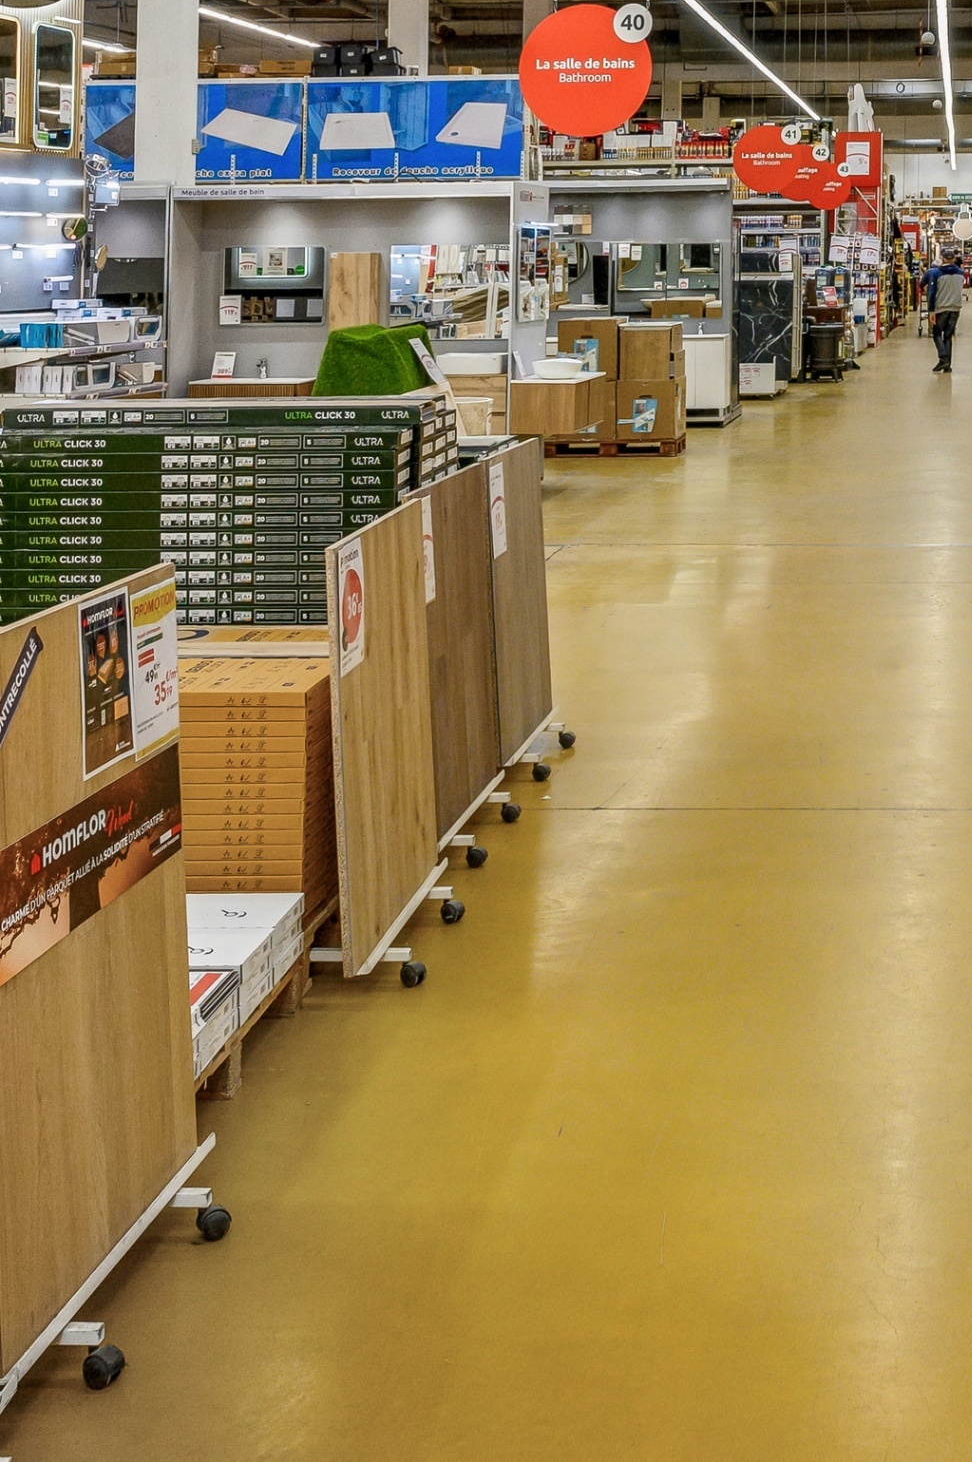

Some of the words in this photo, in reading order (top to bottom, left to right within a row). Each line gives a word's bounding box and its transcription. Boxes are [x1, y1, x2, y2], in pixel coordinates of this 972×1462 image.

[620, 14, 645, 31] 40
[536, 59, 550, 70] La
[553, 58, 582, 69] salle
[584, 58, 600, 69] de
[602, 58, 635, 69] bains
[558, 72, 612, 83] Bathroom
[784, 130, 797, 139] 41
[815, 148, 826, 156] 42
[218, 170, 246, 178] exra
[250, 169, 272, 178] plat
[401, 166, 438, 176] douche
[249, 188, 264, 196] bain
[17, 413, 45, 423] ULTRA
[285, 410, 313, 420] ULTRA
[315, 411, 343, 419] CLICK
[344, 411, 356, 419] 30
[381, 410, 410, 419] ULTRA
[33, 440, 62, 449] ULTRA
[64, 440, 93, 449] CLICK
[94, 440, 107, 449] 30
[260, 438, 269, 446] 20
[354, 437, 384, 446] ULTRA
[30, 459, 59, 468] ULTRA
[61, 459, 90, 468] CLICK
[91, 459, 104, 468] 30
[351, 456, 381, 465] ULTRA
[30, 478, 59, 487] ULTRA
[60, 478, 89, 487] CLICK
[91, 478, 103, 487] 30
[351, 476, 381, 485] ULTRA
[29, 497, 58, 507] ULTRA
[60, 497, 89, 507] CLICK
[90, 497, 103, 507] 30
[351, 495, 380, 504] ULTRA
[29, 516, 58, 525] ULTRA
[59, 516, 88, 525] CLICK
[90, 516, 102, 525] 30
[29, 536, 58, 545] ULTRA
[59, 536, 88, 545] CLICK
[90, 536, 102, 545] 30
[29, 555, 57, 564] ULTRA
[59, 555, 88, 564] CLICK
[90, 555, 102, 564] 30
[28, 574, 57, 583] ULTRA
[59, 574, 88, 583] CLICK
[89, 574, 102, 583] 30
[29, 594, 58, 603] ULTRA
[134, 591, 174, 620] PROMOTION
[86, 607, 114, 626] HOMFLOR
[154, 680, 166, 706] 35
[42, 808, 107, 868] HOMFLOR
[1, 902, 30, 932] CHARME
[30, 894, 46, 912] D'UN
[46, 872, 75, 900] PARQUET
[75, 859, 92, 882] ALLIÉ
[90, 855, 96, 869] À
[96, 856, 104, 868] LA
[103, 832, 128, 860] SOLIDITÉ
